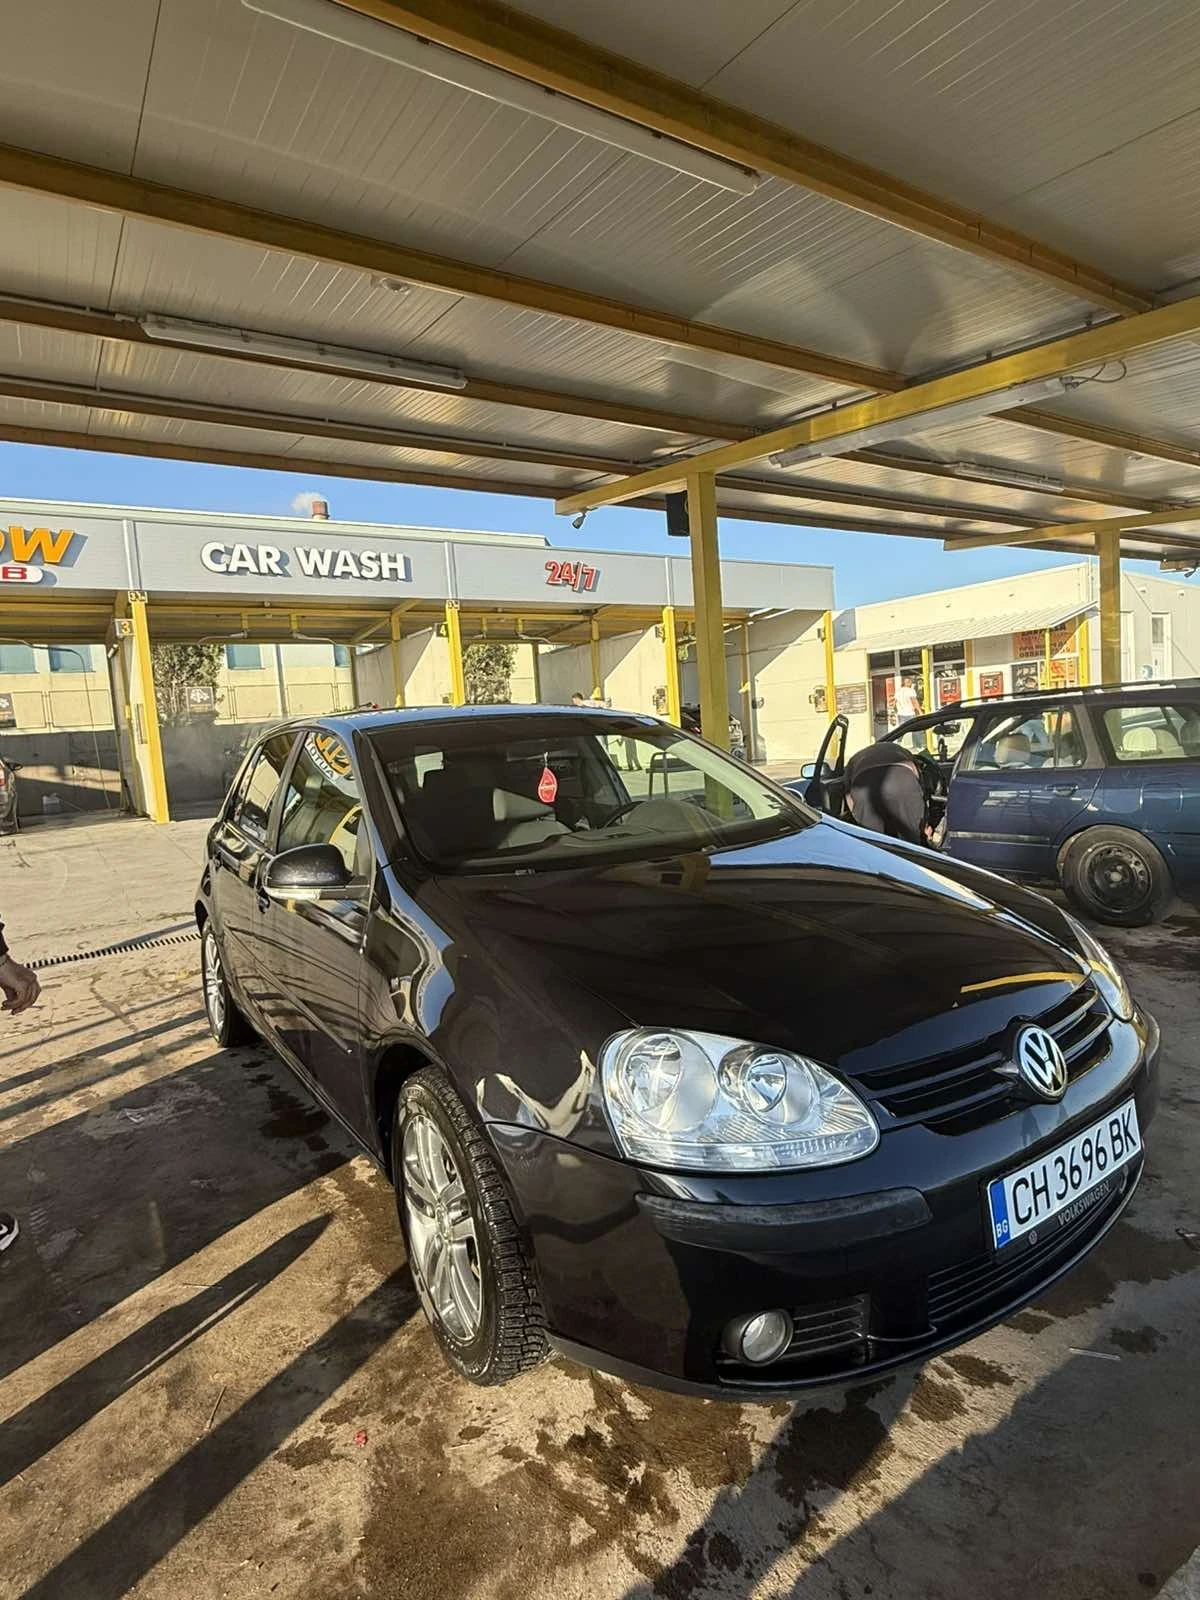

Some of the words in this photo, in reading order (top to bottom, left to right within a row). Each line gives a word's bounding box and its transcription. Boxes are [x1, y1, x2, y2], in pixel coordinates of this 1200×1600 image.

[201, 541, 284, 575] CAR
[294, 547, 406, 580] WASH
[545, 560, 597, 591] 24/7
[121, 621, 131, 635] 3
[440, 625, 447, 637] 4
[1013, 1165, 1051, 1225] CH
[1054, 1129, 1107, 1201] 3696
[1109, 1108, 1136, 1162] BK
[1057, 1180, 1110, 1226] VOLKSWAGEN
[996, 1219, 1008, 1237] BG
